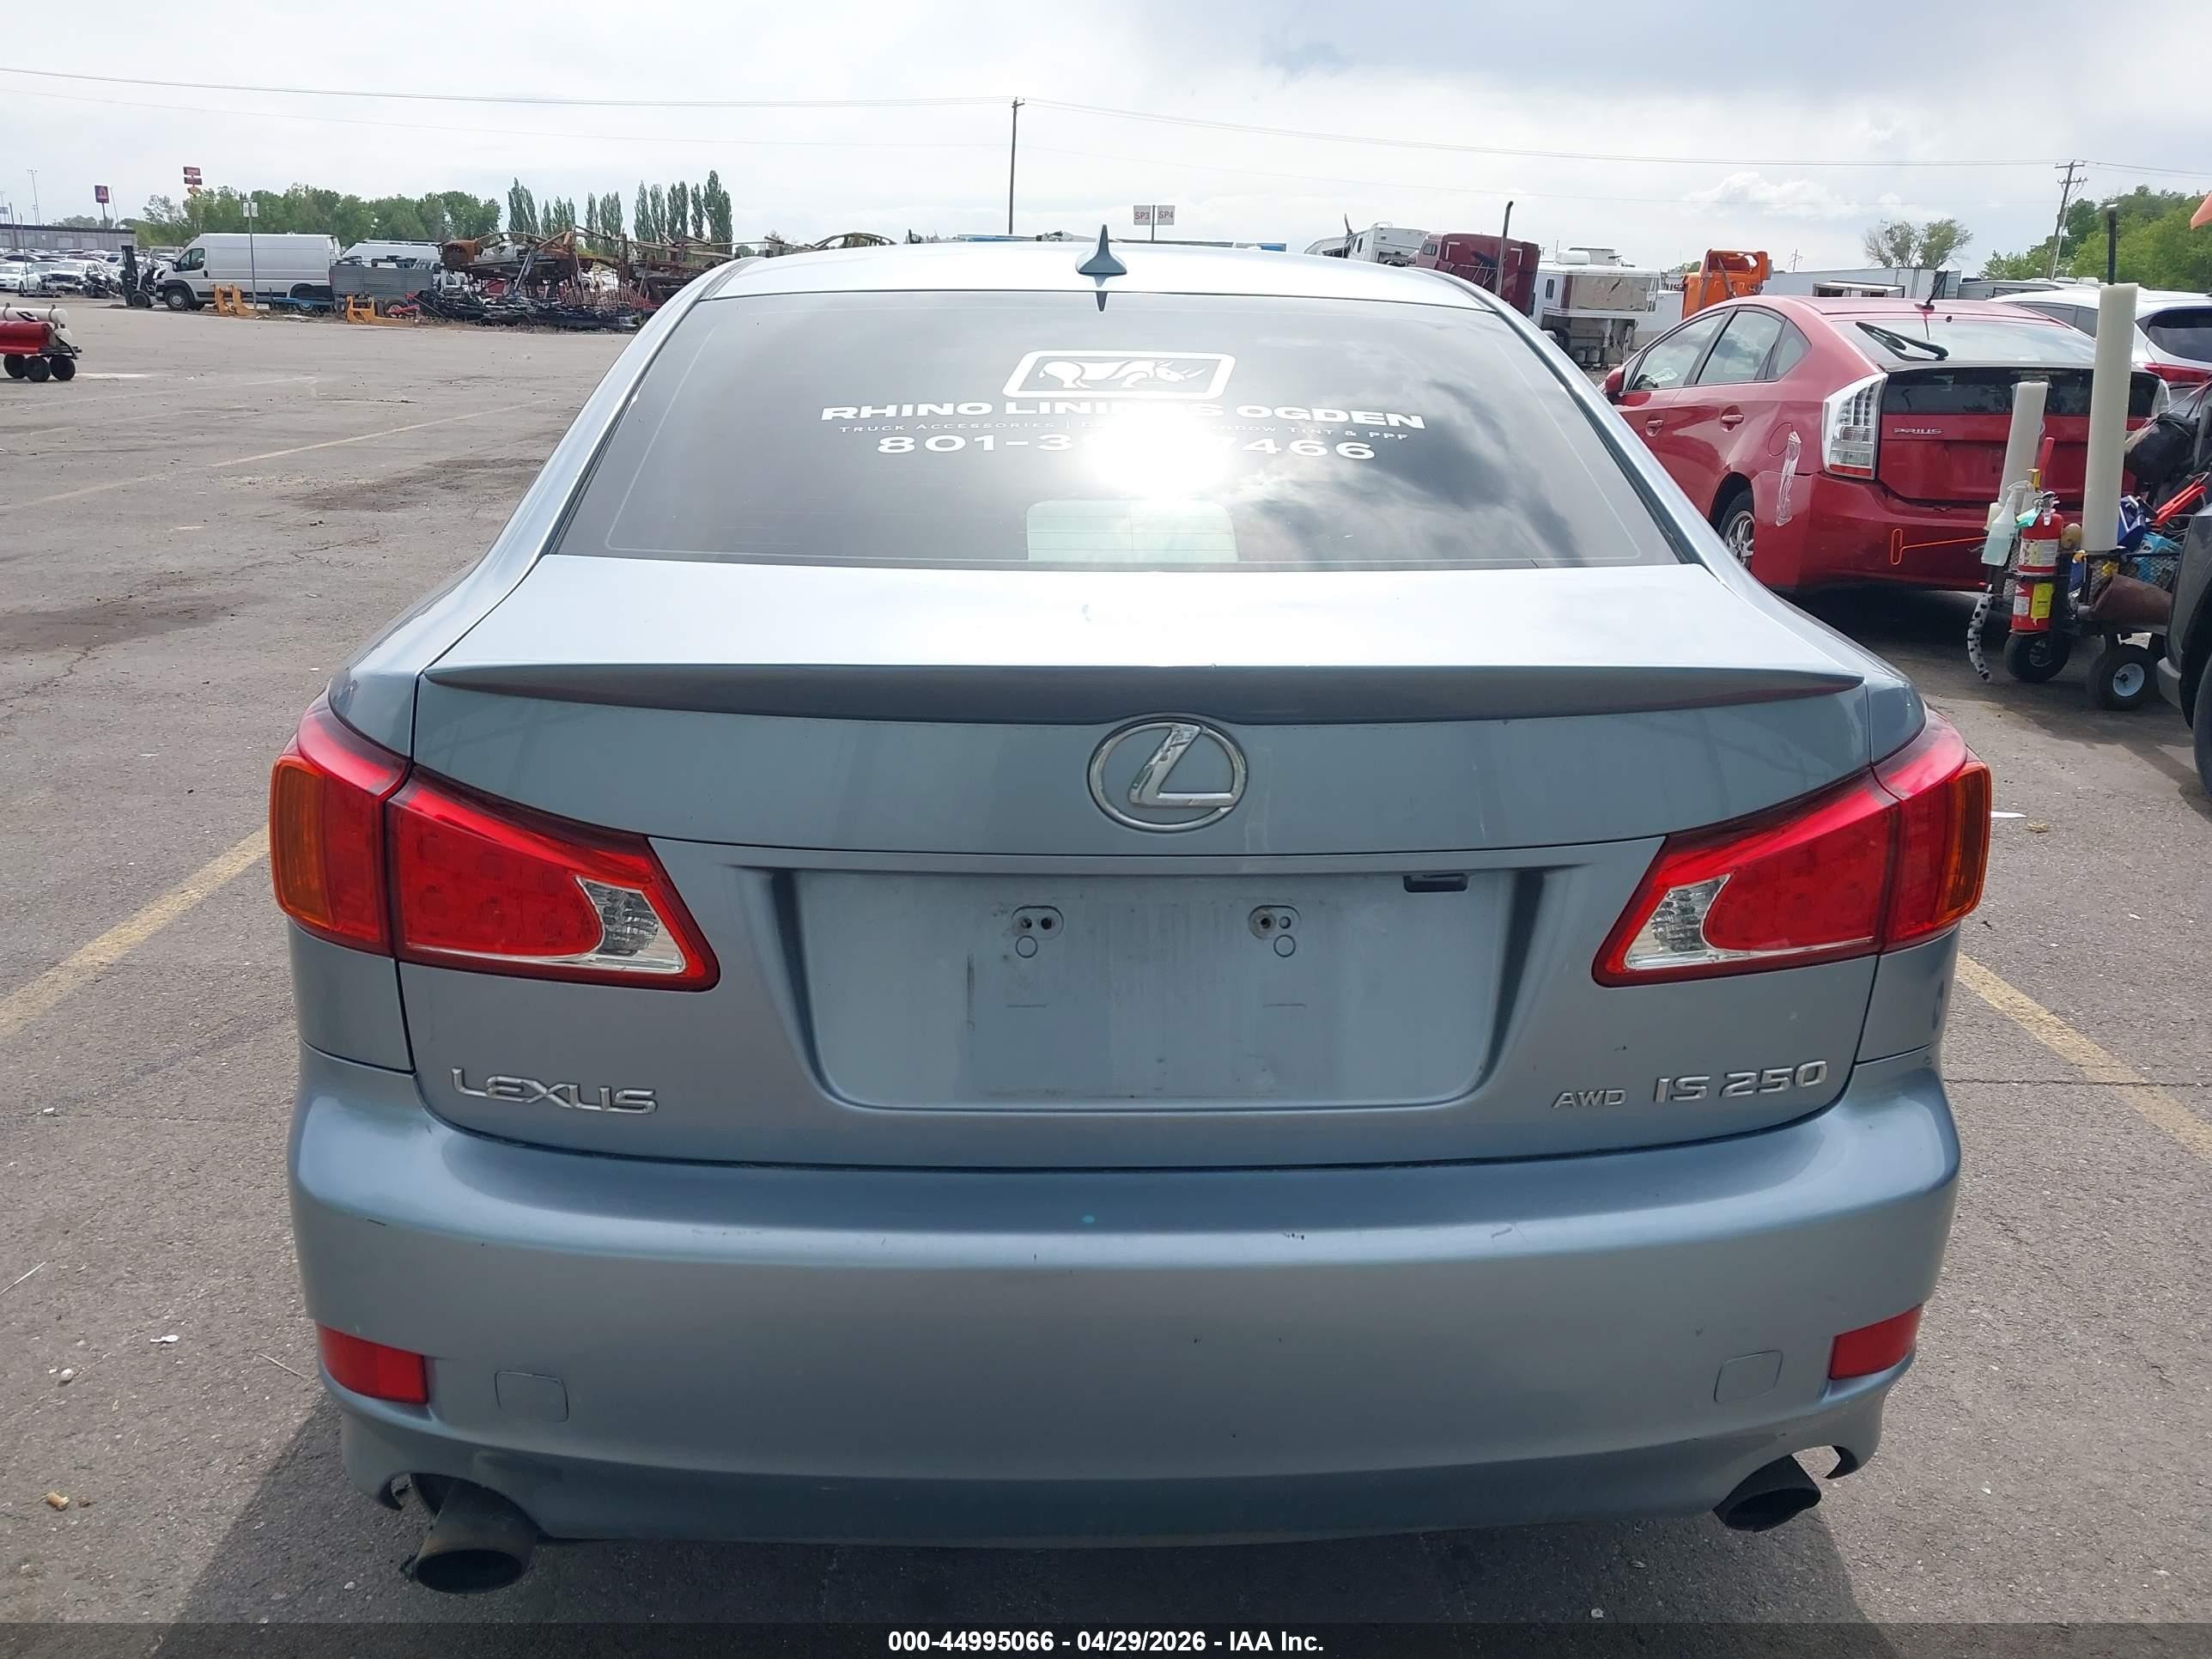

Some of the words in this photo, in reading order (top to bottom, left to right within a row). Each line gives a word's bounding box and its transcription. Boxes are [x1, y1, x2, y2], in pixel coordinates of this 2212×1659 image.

[1134, 211, 1150, 220] SP3
[1158, 210, 1174, 220] SP4
[821, 402, 993, 420] RHINO
[1005, 401, 1224, 416] LINIS
[1236, 404, 1426, 429] OGDEN
[915, 422, 1055, 430] ACCESSORIES
[1287, 426, 1334, 434] TINT
[451, 1067, 658, 1115] LEXUS
[1552, 1089, 1627, 1109] AWD
[1654, 1075, 1711, 1103] IS
[1720, 1060, 1829, 1098] 250
